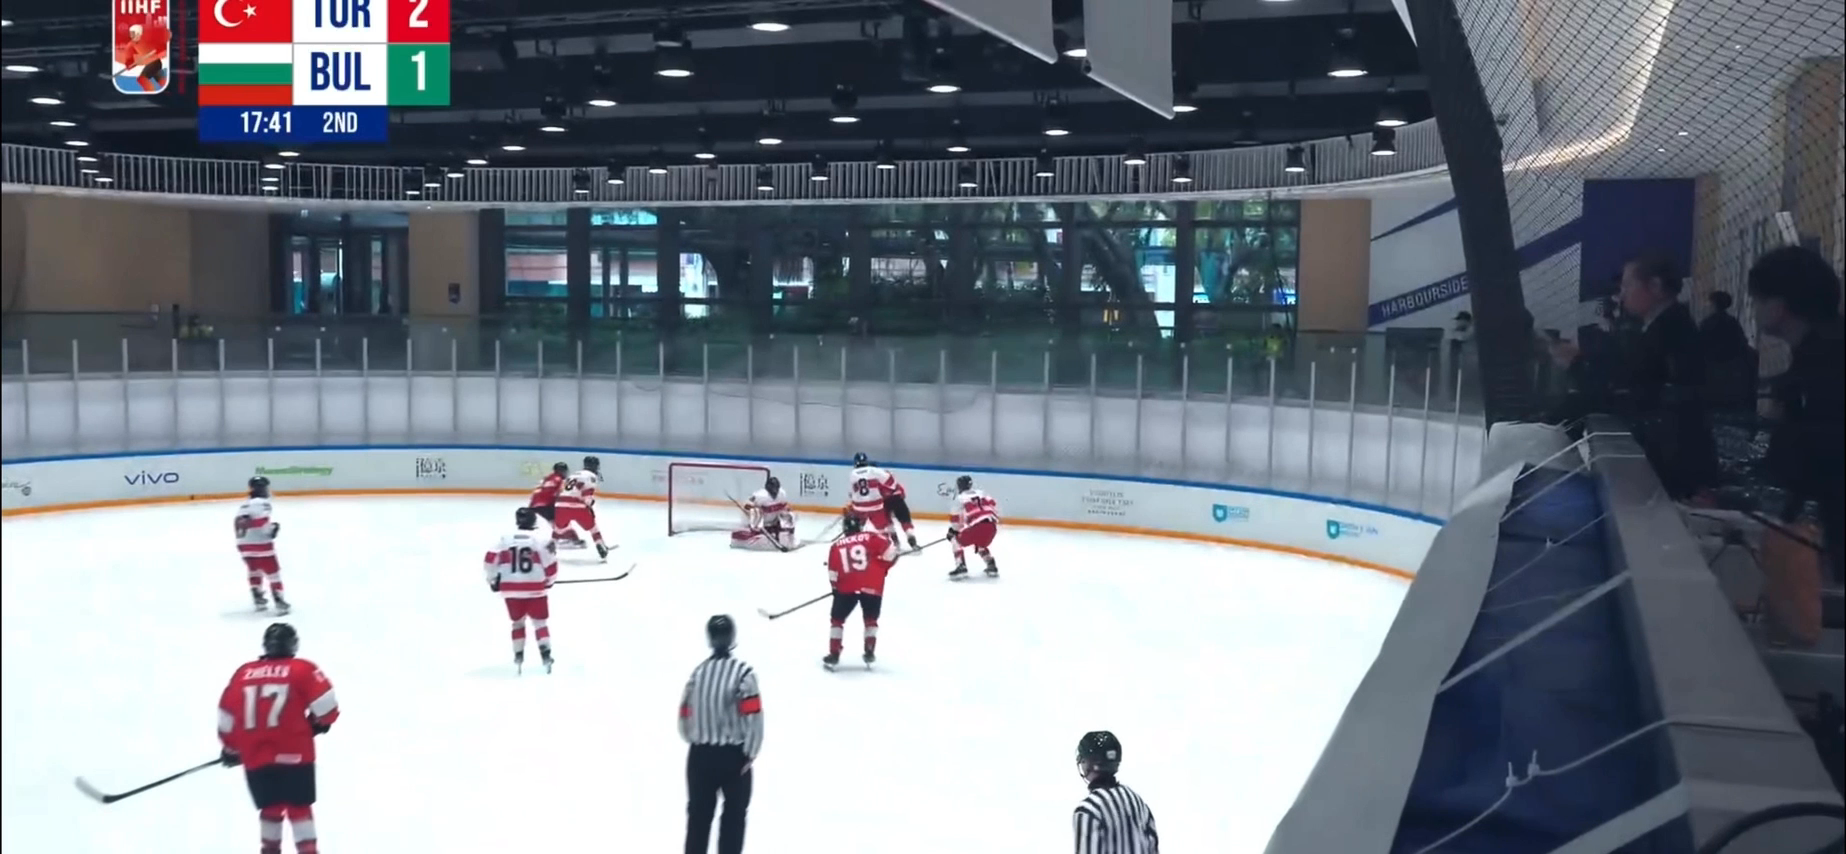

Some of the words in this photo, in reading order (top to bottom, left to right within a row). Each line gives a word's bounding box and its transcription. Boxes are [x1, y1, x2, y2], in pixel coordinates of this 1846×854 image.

[1381, 276, 1468, 317] HARBOURSIDE
[124, 470, 179, 485] vivo
[508, 546, 532, 574] 16
[839, 544, 868, 573] 19
[243, 683, 290, 730] 17
